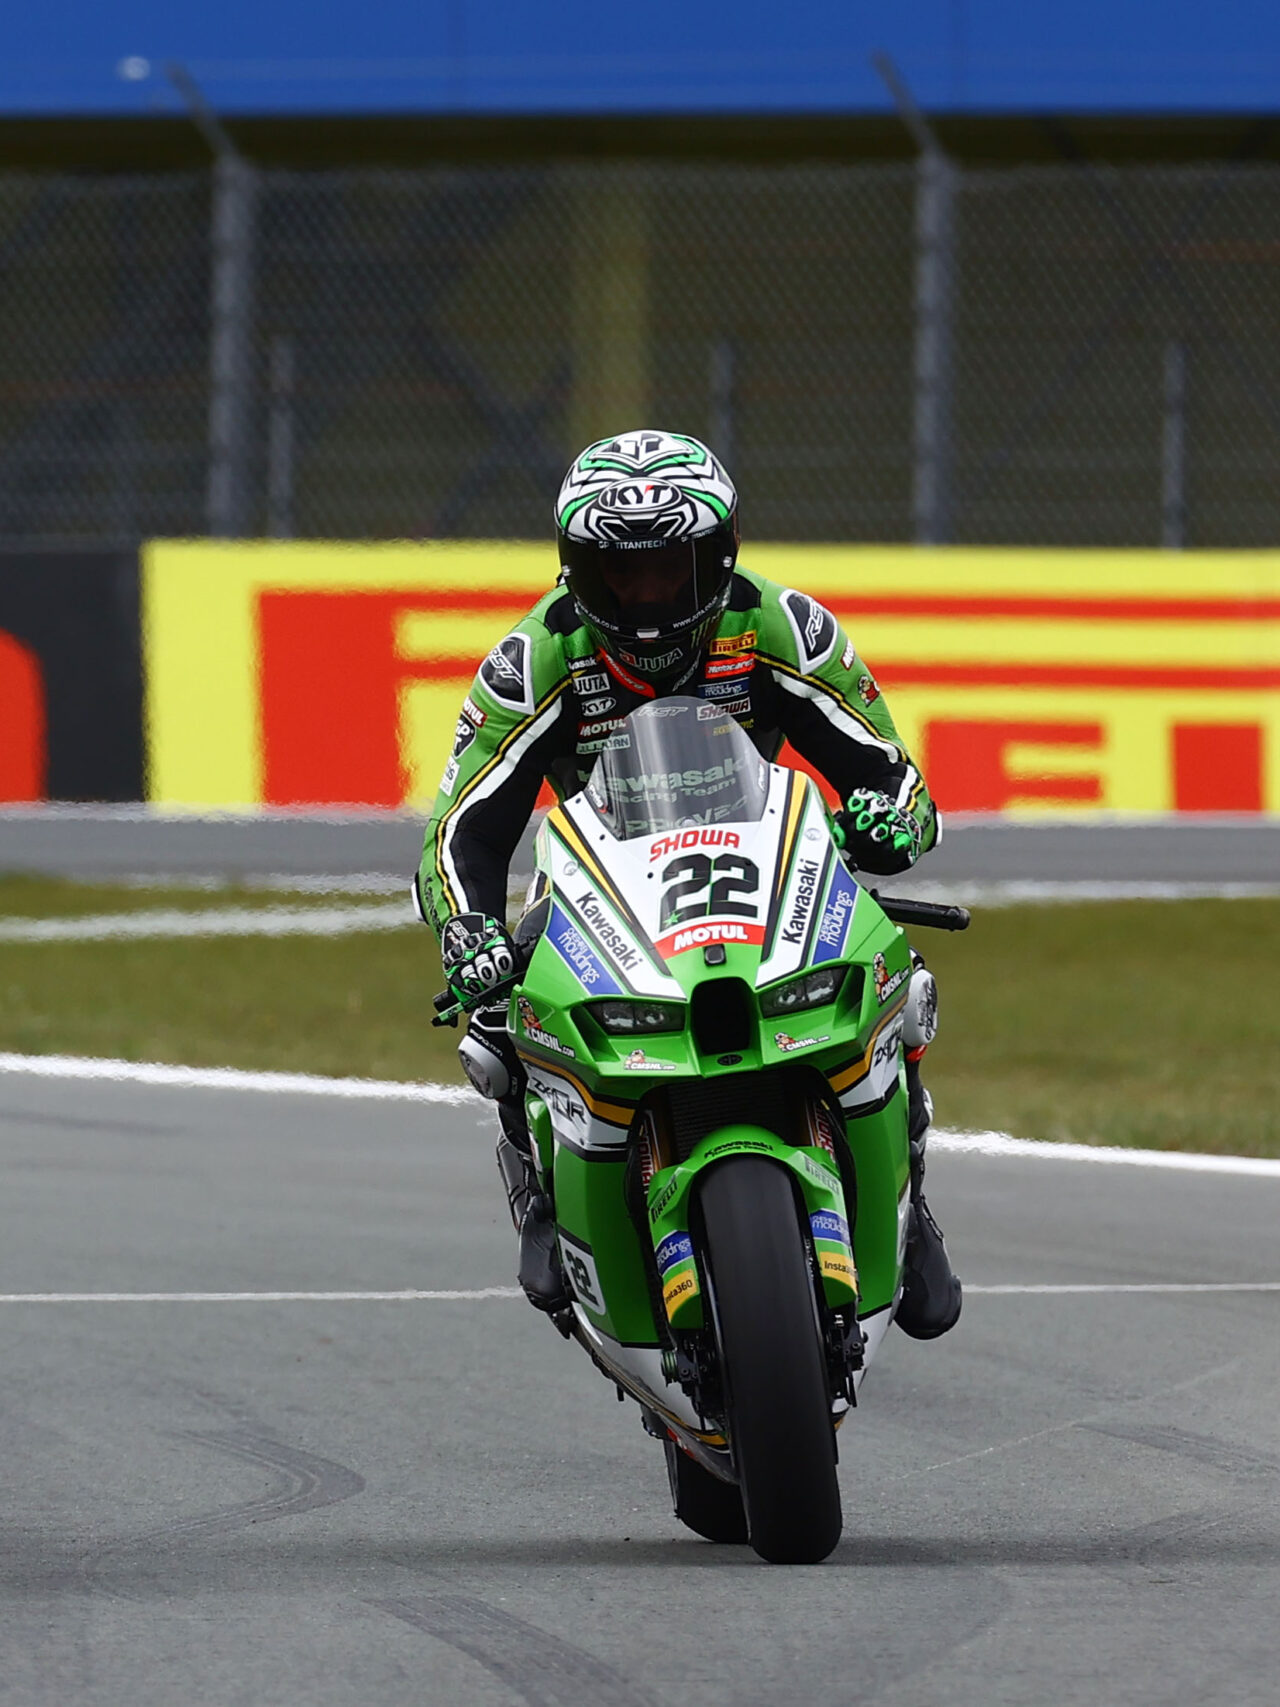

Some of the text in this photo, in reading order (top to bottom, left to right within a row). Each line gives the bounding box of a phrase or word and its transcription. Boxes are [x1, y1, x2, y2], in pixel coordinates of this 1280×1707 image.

[609, 484, 672, 507] KYT
[615, 539, 667, 550] TITANTECH
[636, 648, 683, 673] JUTA
[575, 674, 608, 693] JUTA
[463, 697, 484, 725] OTUL
[638, 706, 688, 718] RST
[700, 700, 749, 718] SHOWA
[580, 718, 627, 736] MOTUL
[613, 791, 677, 804] acing
[680, 778, 736, 797] Team
[650, 830, 740, 862] SHOWA
[659, 852, 760, 933] 22
[781, 858, 819, 945] Kawasaki
[575, 891, 644, 971] Kawasaki
[826, 890, 853, 947] mouldings
[674, 925, 748, 950] MOTUL
[557, 930, 600, 983] mouldings
[704, 1141, 774, 1159] Kawasaki
[651, 1180, 678, 1225] PIRELLI
